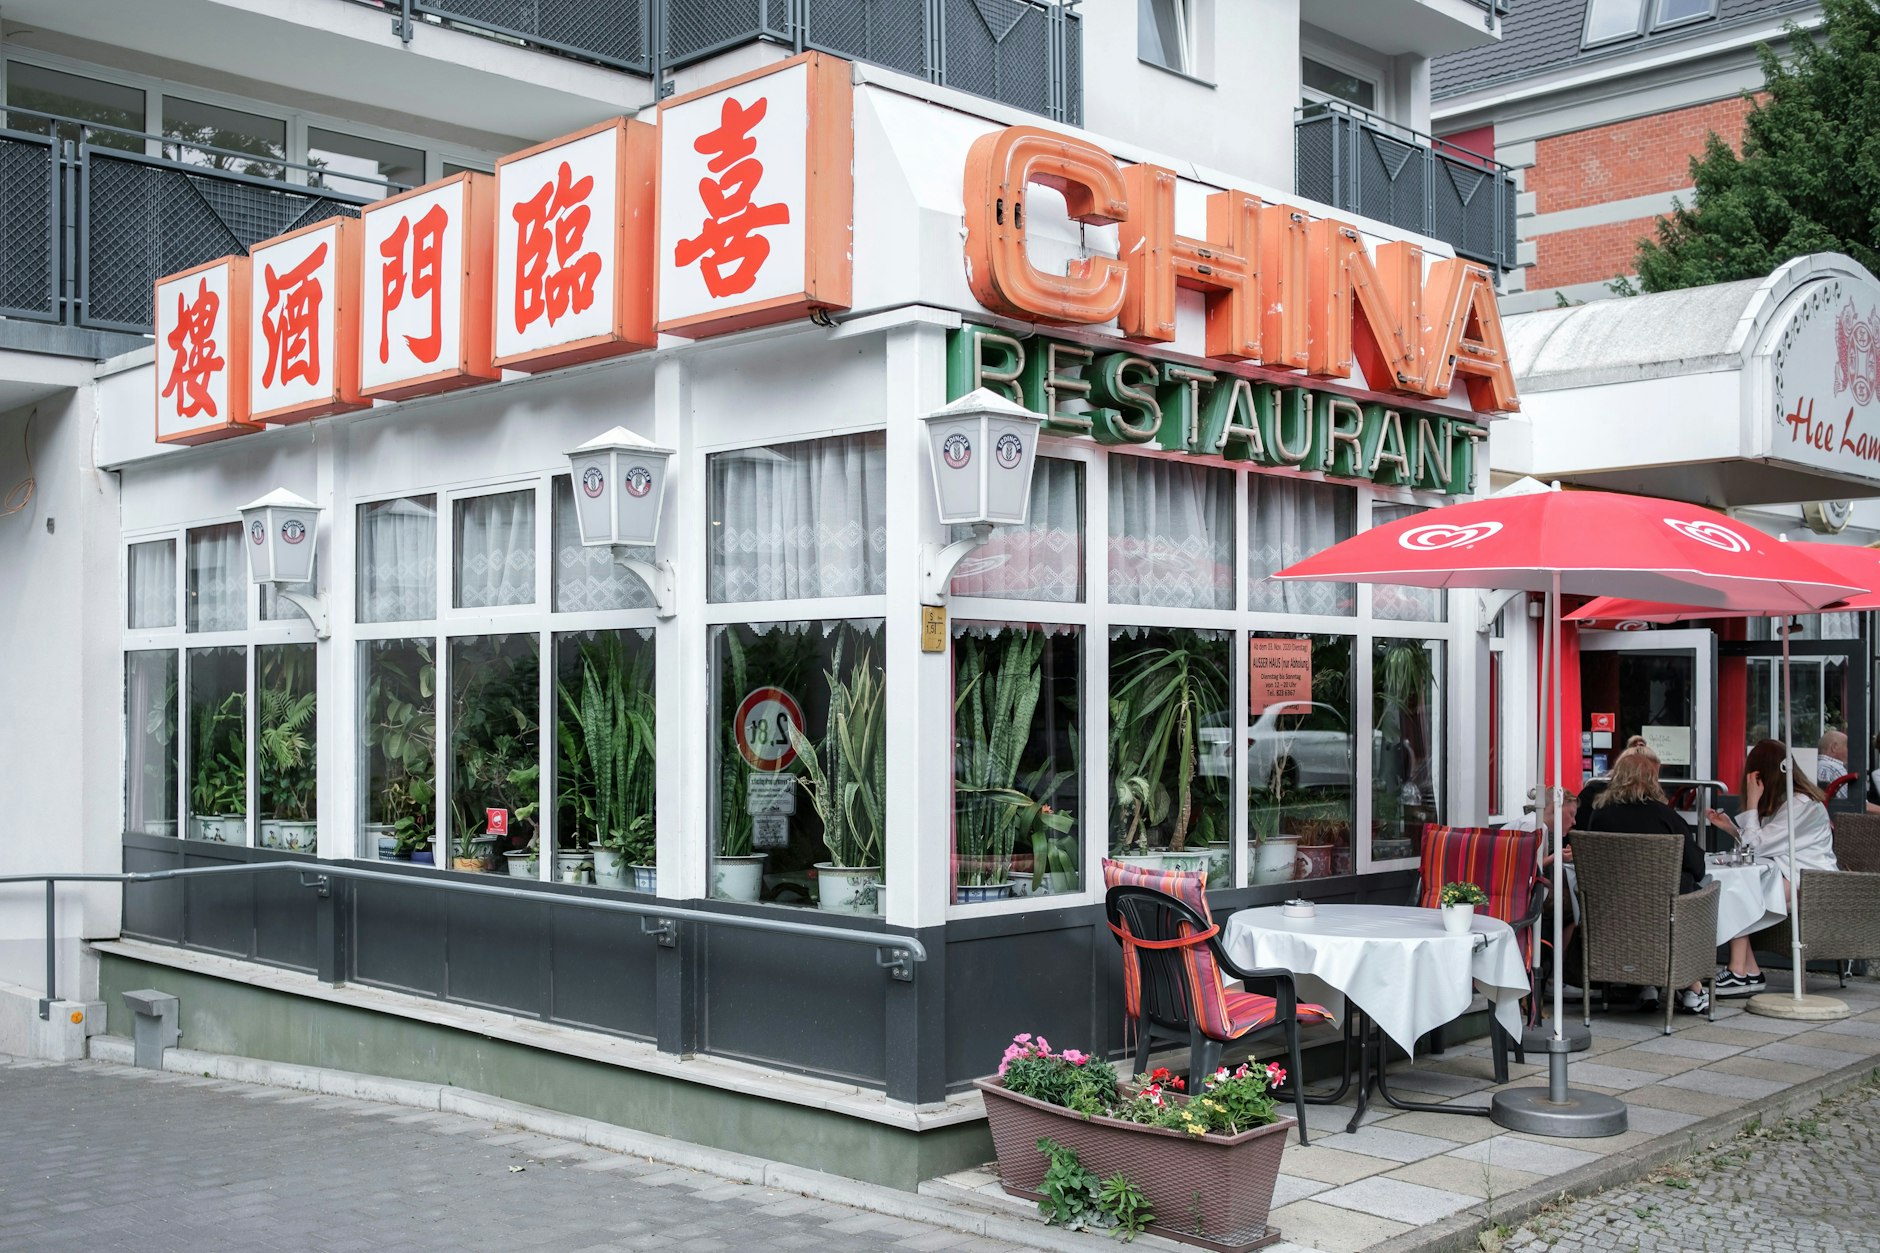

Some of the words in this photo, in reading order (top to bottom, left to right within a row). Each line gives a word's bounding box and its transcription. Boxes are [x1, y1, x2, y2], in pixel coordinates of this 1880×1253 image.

[963, 125, 1521, 415] CHINA
[948, 323, 1490, 494] RESTAURANT
[1786, 396, 1834, 453] Hee
[945, 435, 969, 450] ERDINGER
[998, 435, 1021, 450] ERDINGER
[1253, 657, 1268, 668] AUSSER
[1269, 657, 1281, 668] HAUS
[1261, 673, 1279, 681] Dienstag
